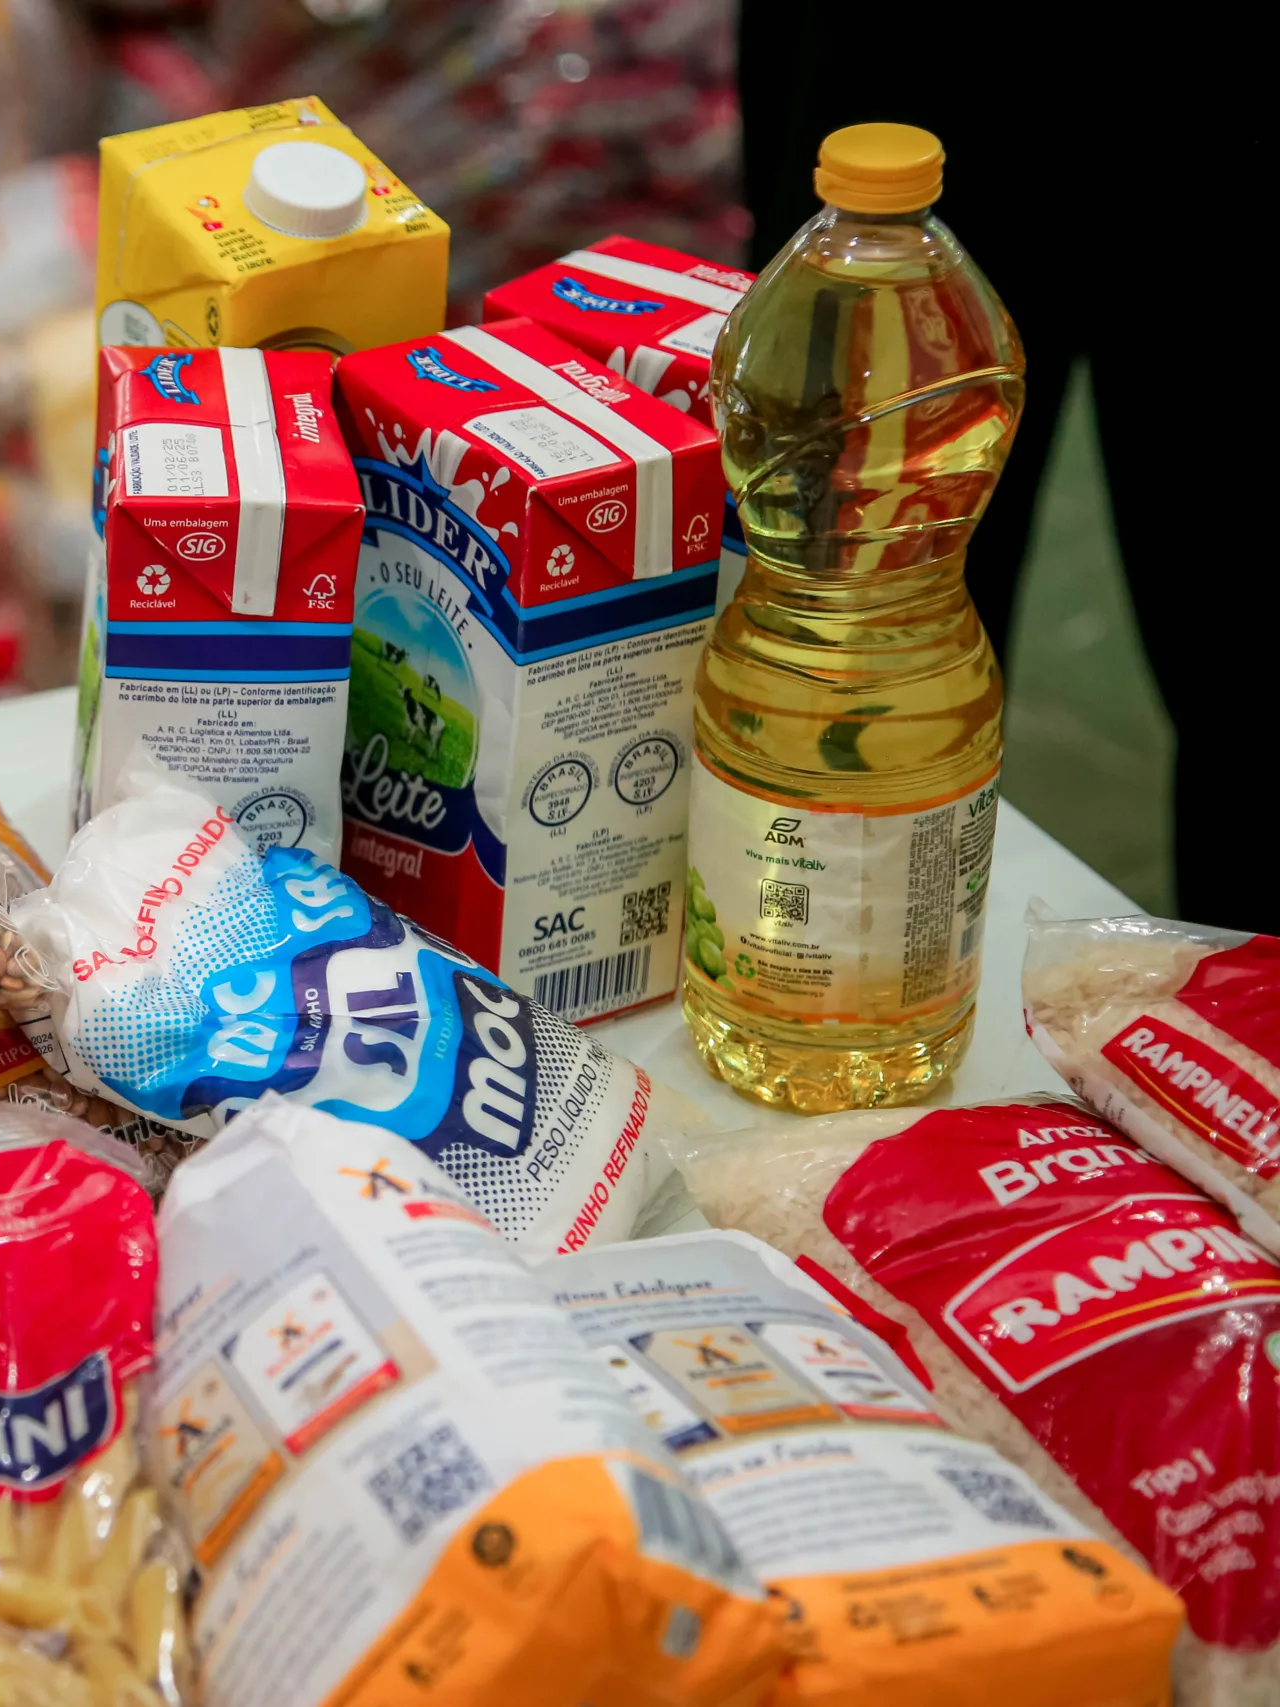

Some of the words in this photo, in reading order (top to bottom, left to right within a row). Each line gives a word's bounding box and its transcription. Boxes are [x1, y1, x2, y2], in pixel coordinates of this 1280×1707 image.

[156, 356, 178, 394] LIDER
[284, 392, 323, 443] integral
[558, 496, 578, 506] Uma
[579, 483, 629, 502] embalagem
[143, 518, 167, 527] Uma
[169, 518, 228, 529] embalagem
[593, 506, 620, 526] SIG
[360, 474, 491, 591] LIDER
[184, 539, 217, 554] SIG
[540, 576, 580, 592] Reciclável
[130, 599, 176, 608] Reciclável
[308, 600, 334, 609] FSC
[380, 561, 389, 583] O
[396, 562, 422, 588] SEU
[428, 579, 469, 636] LEITE
[120, 682, 163, 693] Fabricado
[181, 686, 198, 696] (LL)
[213, 687, 231, 697] (LP)
[241, 687, 281, 696] Conforme
[284, 685, 336, 696] identificação
[132, 693, 165, 702] carimbo
[168, 695, 179, 703] do
[181, 695, 197, 704] lote
[213, 697, 234, 706] parte
[237, 698, 272, 707] superior
[274, 698, 284, 706] da
[197, 718, 238, 727] Fabricado
[217, 710, 237, 719] (LL)
[624, 744, 669, 770] BRASIL
[343, 733, 447, 830] Leite
[539, 765, 584, 792] BRASIL
[633, 776, 656, 788] 4203
[246, 799, 295, 822] BRASIL
[548, 797, 570, 810] 3948
[257, 831, 282, 842] 4203
[764, 831, 804, 848] ADM
[745, 848, 763, 861] viva
[766, 855, 790, 866] mais
[533, 906, 585, 941] SAC
[519, 944, 546, 958] 0800
[548, 939, 568, 951] 645
[570, 930, 596, 945] 0085
[750, 932, 820, 950] www.vitaliv.com.br
[526, 1128, 567, 1182] PESO
[564, 1067, 598, 1134] LÍQUIDO
[603, 1090, 649, 1188] REFINADO
[1018, 1125, 1112, 1149] Arroz
[991, 1224, 1278, 1344] RAMPIN
[1130, 1458, 1199, 1500] Tipo
